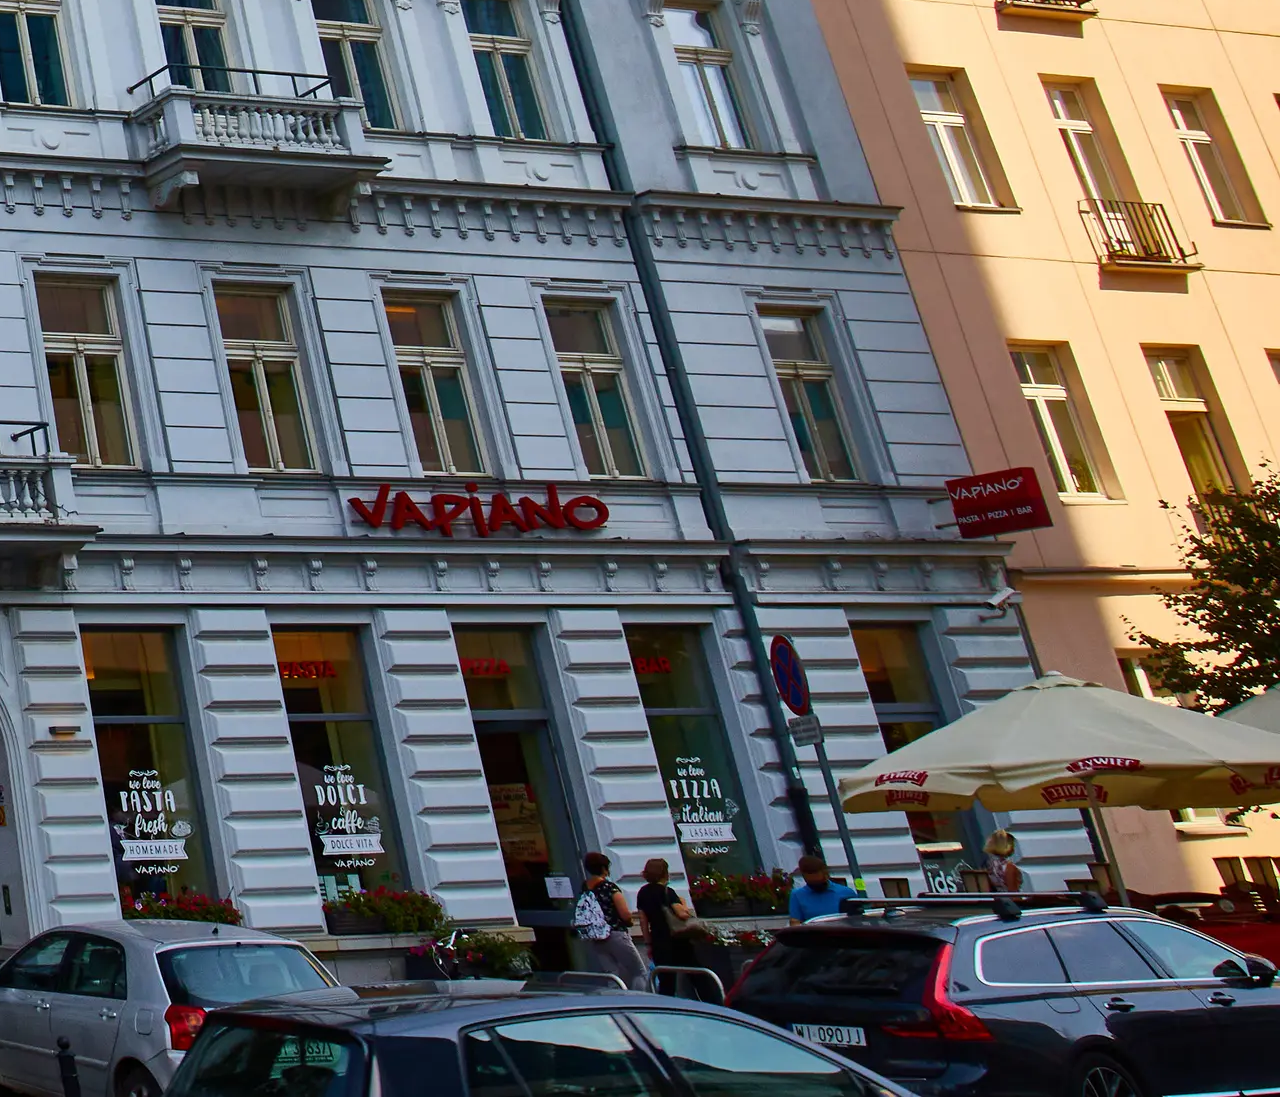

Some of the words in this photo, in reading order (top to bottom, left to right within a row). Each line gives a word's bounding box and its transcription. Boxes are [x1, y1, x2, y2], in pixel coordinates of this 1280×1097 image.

[957, 514, 980, 525] PASTA
[987, 510, 1009, 520] PIZZA
[1016, 505, 1034, 515] BAR
[279, 661, 336, 679] PASTA
[460, 657, 511, 675] PIZZA
[636, 657, 672, 674] BAR
[323, 774, 335, 784] we
[336, 771, 354, 784] love
[688, 764, 705, 777] love
[128, 779, 141, 789] we
[142, 776, 161, 789] love
[669, 778, 722, 799] PIZZA
[119, 789, 176, 813] PASTA
[314, 784, 368, 806] DOLCI
[331, 809, 364, 834] caffe
[682, 803, 724, 823] italian
[134, 813, 168, 838] fresh
[689, 827, 723, 838] LASAGNE
[129, 844, 179, 855] HOMEMADE
[330, 839, 355, 850] DOLCE
[356, 838, 374, 849] VITA
[926, 869, 958, 893] ids
[818, 1026, 861, 1044] 090JJ
